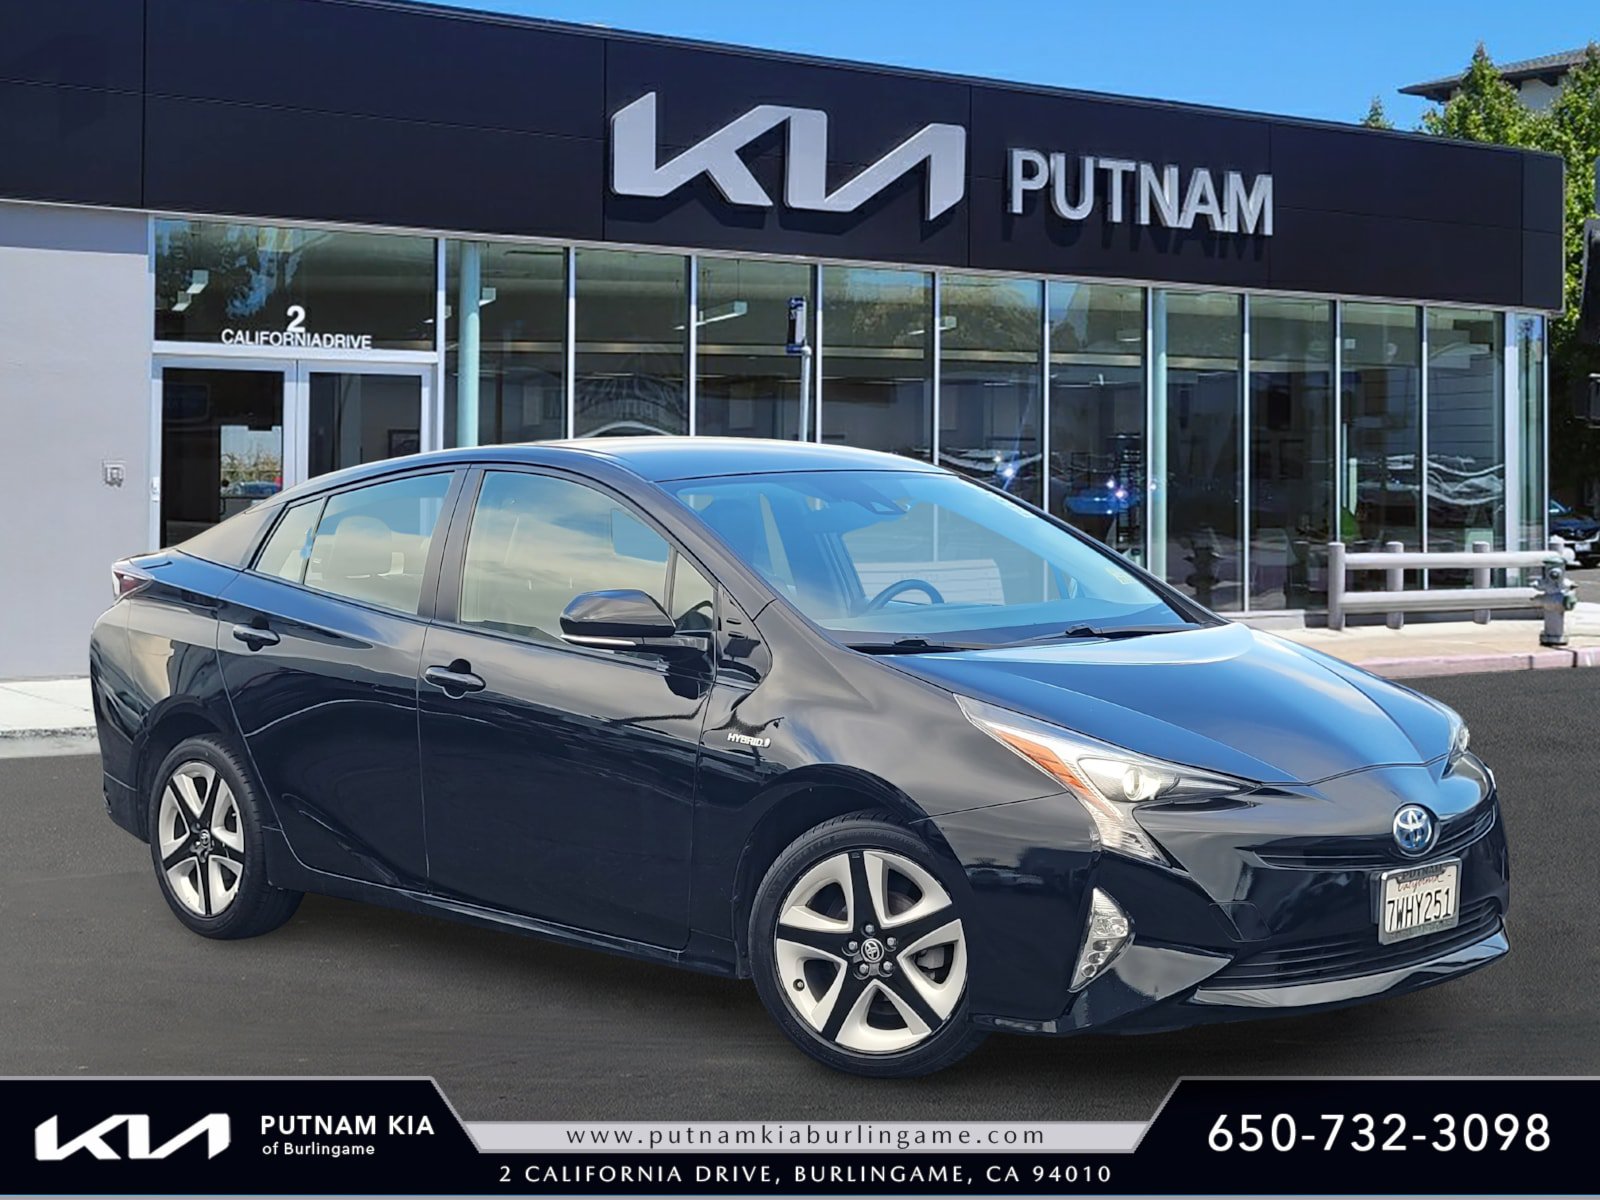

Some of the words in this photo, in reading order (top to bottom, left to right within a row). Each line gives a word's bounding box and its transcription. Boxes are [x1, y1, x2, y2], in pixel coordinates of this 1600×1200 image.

[611, 92, 966, 221] KIA
[1007, 146, 1275, 236] PUTNAM
[286, 305, 306, 333] 2
[727, 733, 764, 747] HYBRID
[1387, 888, 1452, 932] 7WHY251
